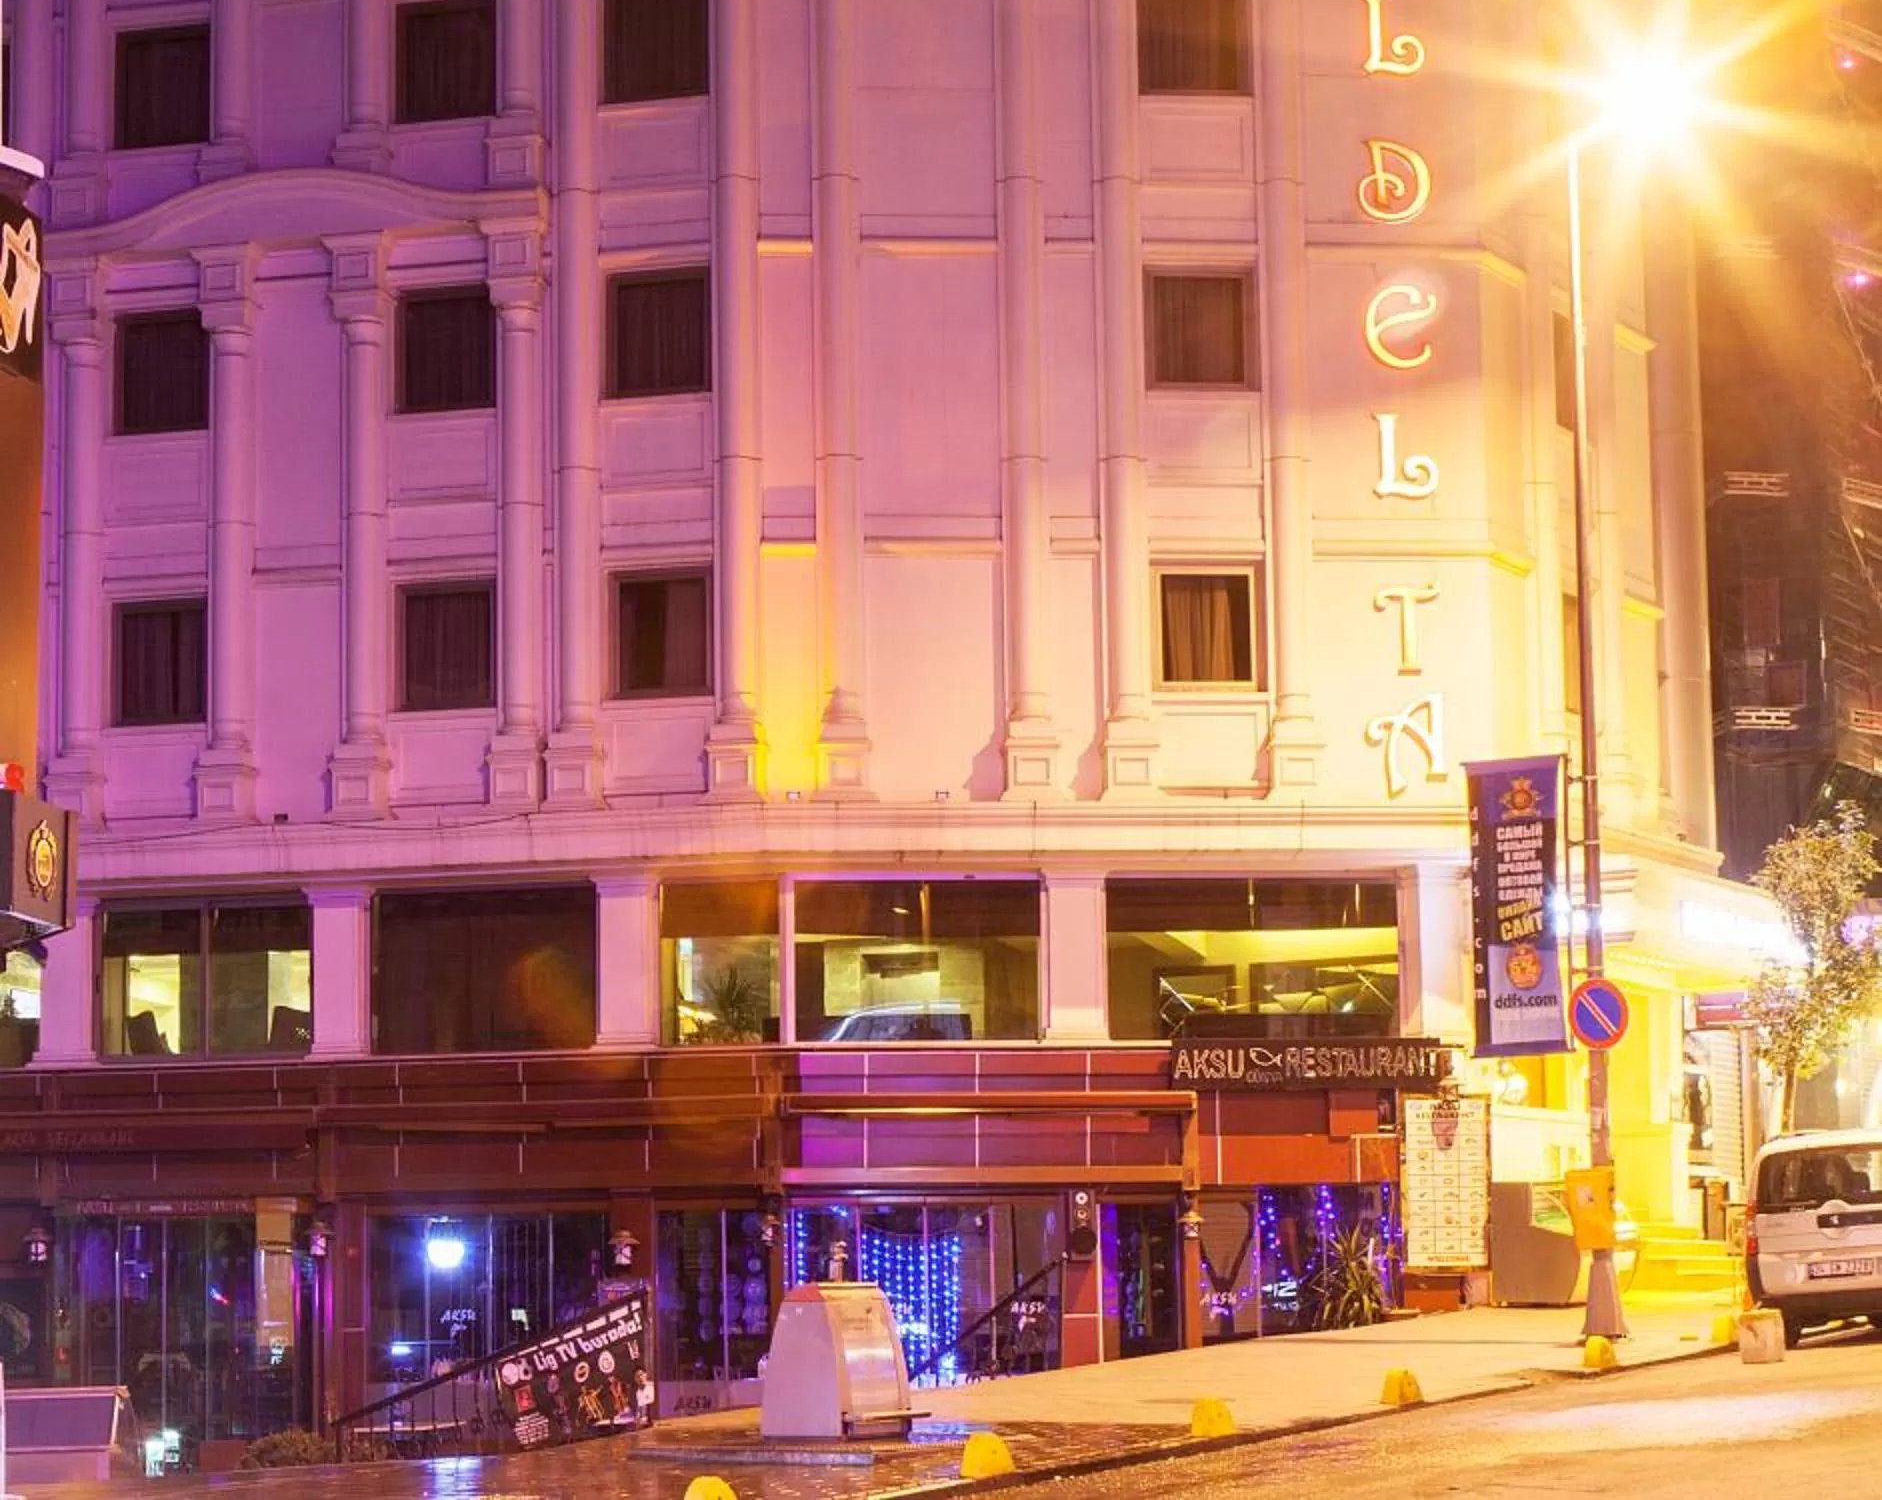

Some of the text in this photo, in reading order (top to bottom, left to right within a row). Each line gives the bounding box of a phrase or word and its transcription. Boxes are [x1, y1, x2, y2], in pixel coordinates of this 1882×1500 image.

[1496, 822, 1543, 841] САМЫЙ
[1501, 911, 1543, 941] САЙТ
[1495, 992, 1557, 1009] ddfs.com
[1174, 1046, 1438, 1080] AKSU RESTAURANT
[555, 1342, 578, 1362] TV
[577, 1312, 643, 1354] burada!
